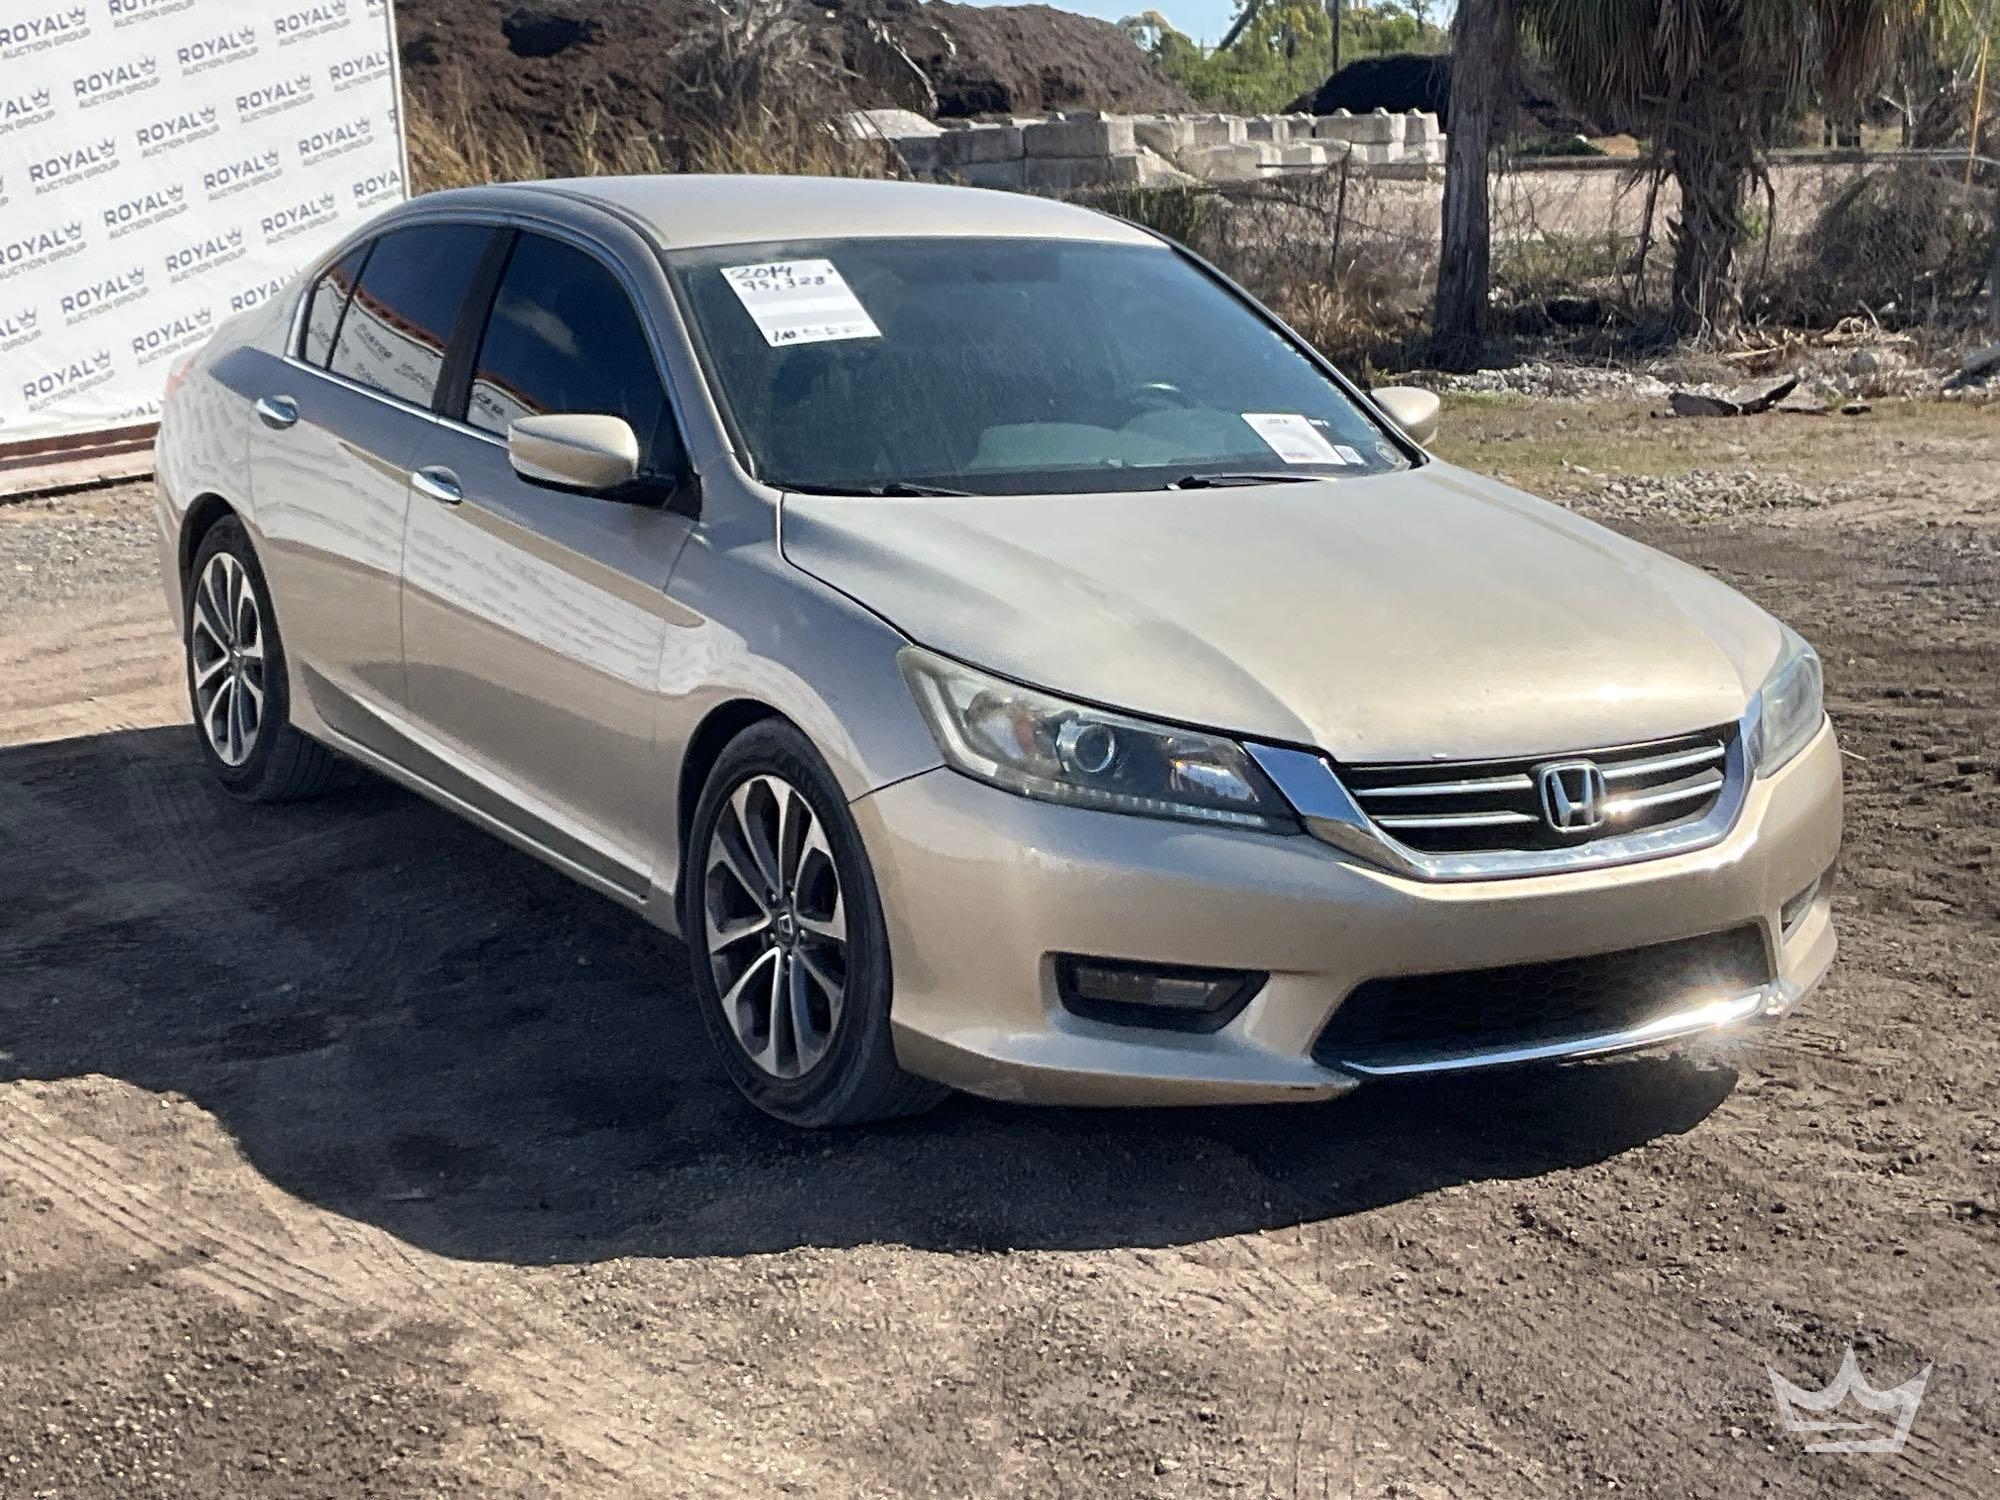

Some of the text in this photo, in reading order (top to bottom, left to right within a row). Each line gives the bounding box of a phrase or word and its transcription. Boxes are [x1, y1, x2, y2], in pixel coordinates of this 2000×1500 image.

[0, 14, 70, 46] ROYAL
[114, 10, 158, 28] AUCTION
[275, 5, 333, 34] ROYAL
[3, 39, 52, 59] AUCTION
[178, 34, 240, 64] ROYAL
[279, 28, 319, 46] AUCTION
[182, 57, 224, 76] AUCTION
[330, 52, 385, 81] ROYAL
[73, 63, 141, 97] ROYAL
[334, 75, 372, 92] AUCTION
[79, 89, 124, 109] AUCTION
[236, 81, 296, 112] ROYAL
[241, 105, 281, 124] AUCTION
[136, 113, 201, 146] ROYAL
[298, 125, 357, 156] ROYAL
[142, 137, 185, 158] AUCTION
[303, 149, 342, 167] AUCTION
[29, 147, 100, 182] ROYAL
[204, 157, 264, 190] ROYAL
[35, 172, 83, 195] AUCTION
[208, 182, 249, 201] AUCTION
[353, 170, 399, 198] ROYA
[104, 192, 168, 227] ROYAL
[358, 189, 396, 209] AUCTION
[109, 219, 153, 240] AUCTION
[261, 202, 320, 234] ROYAL
[266, 227, 305, 246] AUCTION
[165, 235, 227, 272] ROYAL
[170, 261, 213, 283] AUCTION
[60, 275, 129, 314] ROYAL
[66, 302, 113, 327] AUCTION
[132, 316, 196, 354] ROYAL
[138, 344, 181, 367] AUCTION
[22, 357, 94, 400] ROYAL
[28, 387, 77, 412] AUCTION
